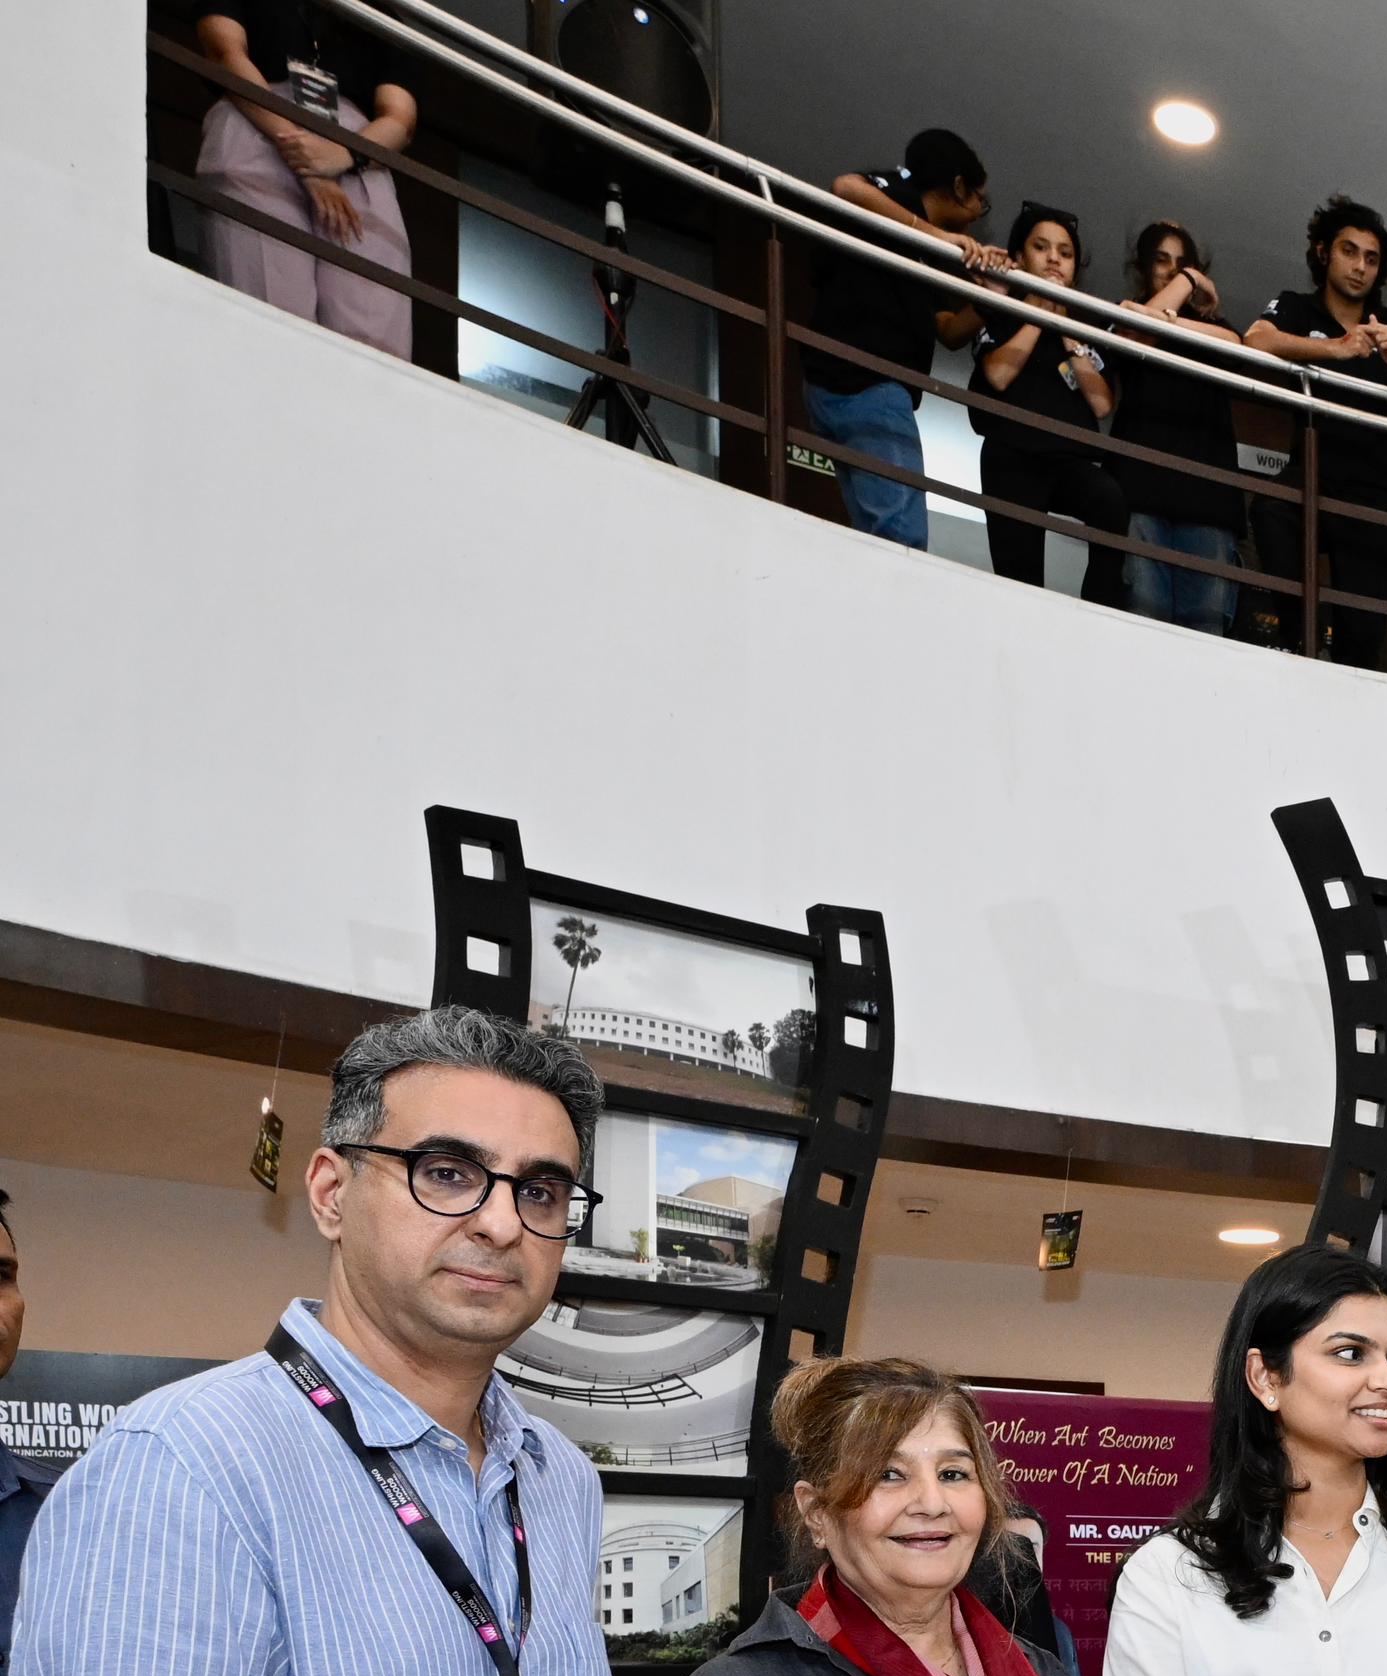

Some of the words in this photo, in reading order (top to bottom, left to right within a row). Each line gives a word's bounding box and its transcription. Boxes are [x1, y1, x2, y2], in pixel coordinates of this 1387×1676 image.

[1256, 453, 1288, 469] WOR
[79, 1403, 128, 1426] WO
[984, 1418, 1046, 1446] When
[1051, 1425, 1089, 1447] Art
[1098, 1426, 1176, 1451] Becomes
[997, 1459, 1058, 1483] Power
[1063, 1458, 1092, 1491] Of
[1090, 1464, 1110, 1485] A
[1116, 1463, 1179, 1487] Nation
[1069, 1524, 1102, 1538] MR.
[1085, 1552, 1111, 1564] THE
